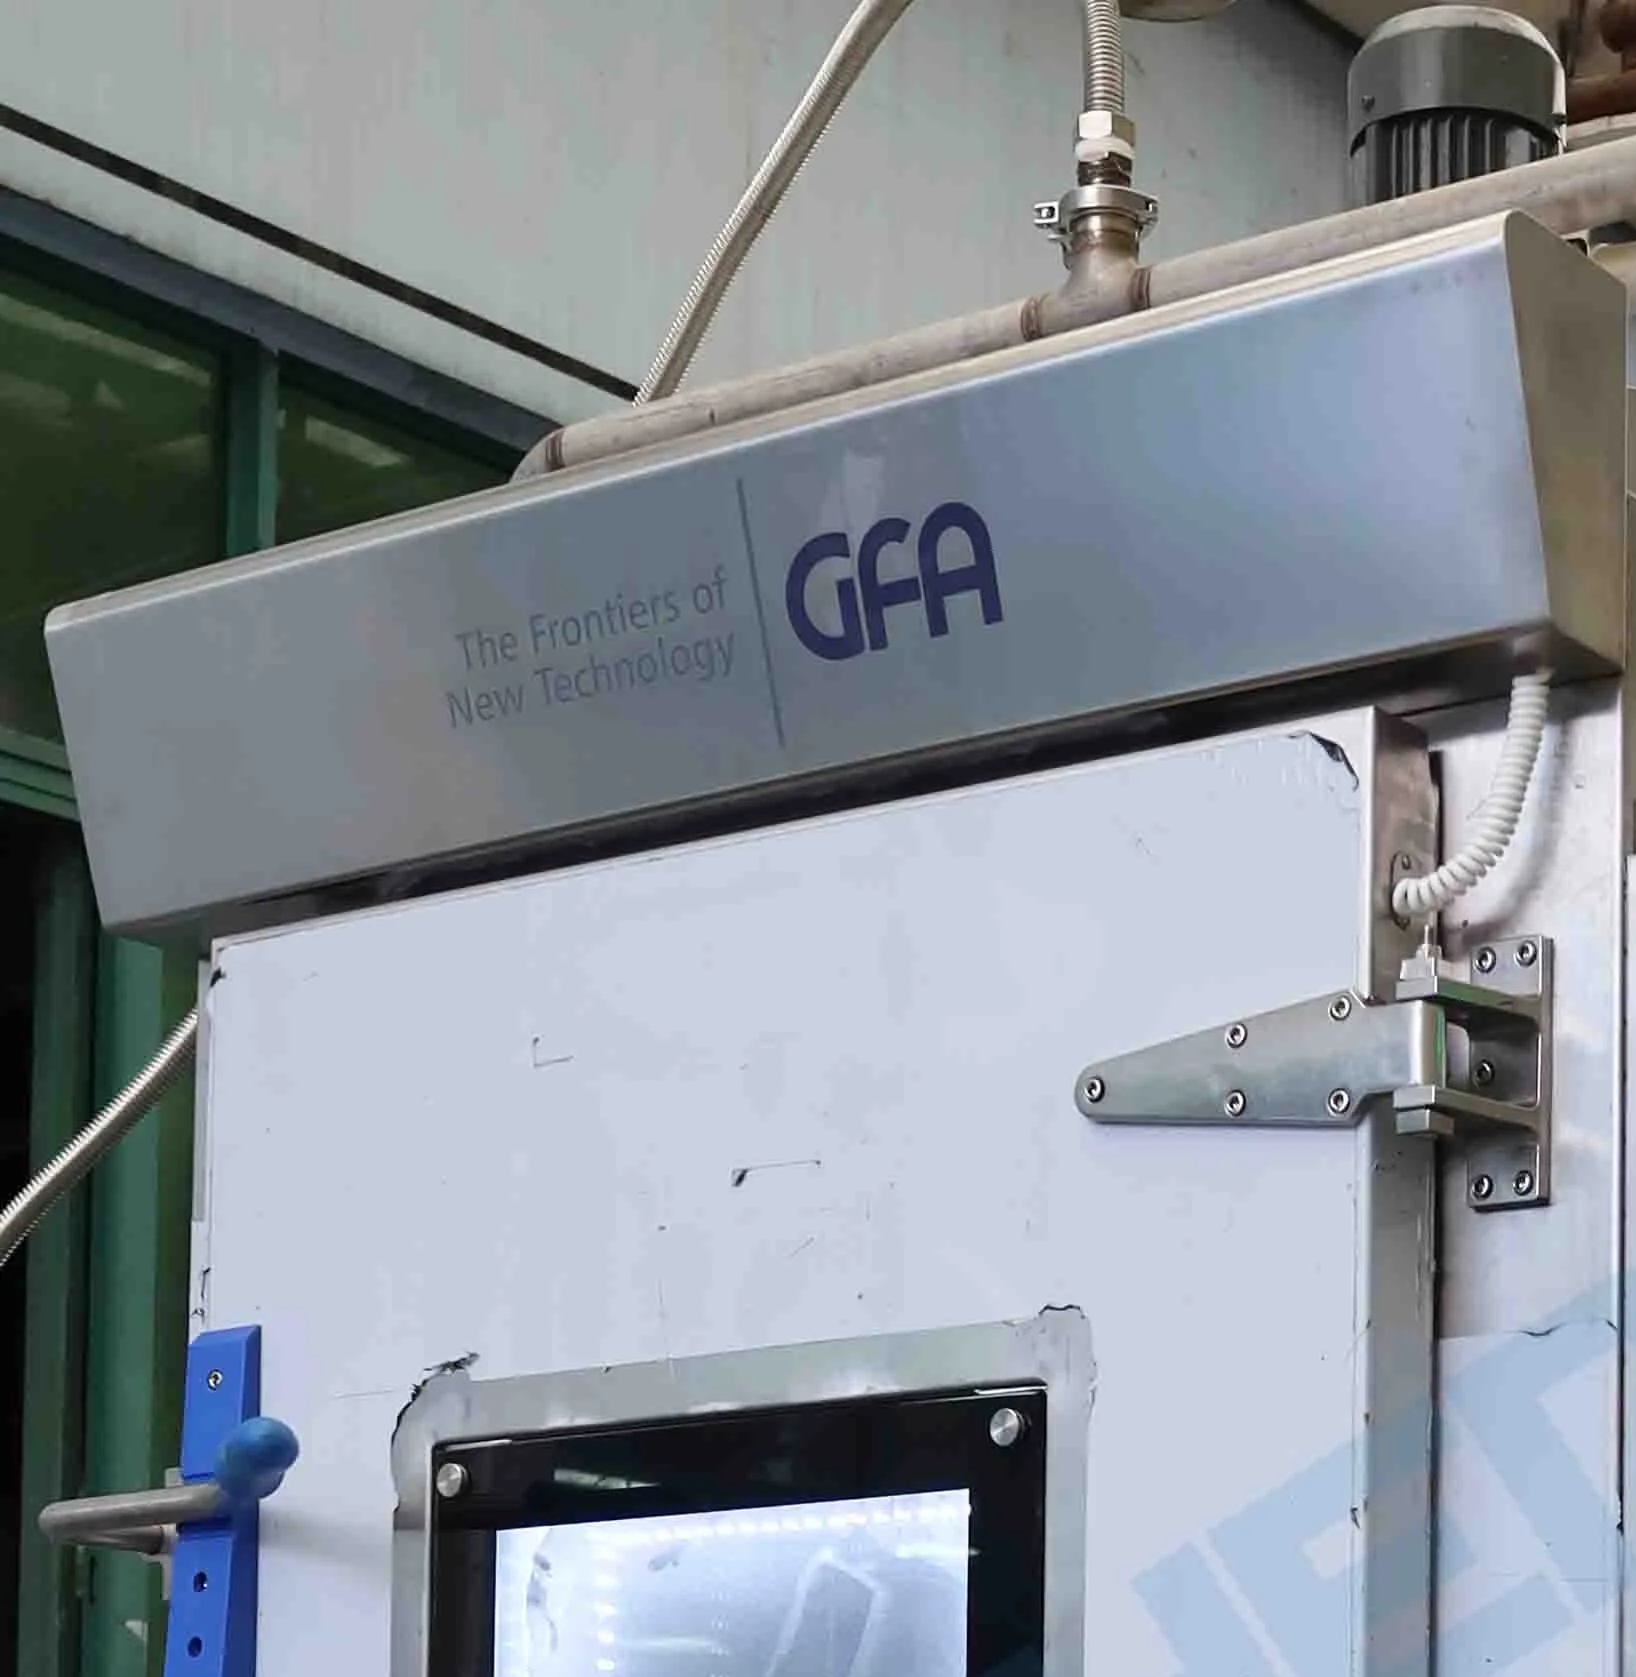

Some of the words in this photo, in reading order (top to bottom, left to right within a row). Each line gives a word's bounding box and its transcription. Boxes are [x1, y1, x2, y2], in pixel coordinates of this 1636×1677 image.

[456, 629, 519, 671] The
[530, 592, 682, 654] Frontiers
[691, 566, 728, 614] of
[785, 501, 1003, 661] GFA
[446, 683, 525, 729] New
[534, 631, 735, 706] Technology
